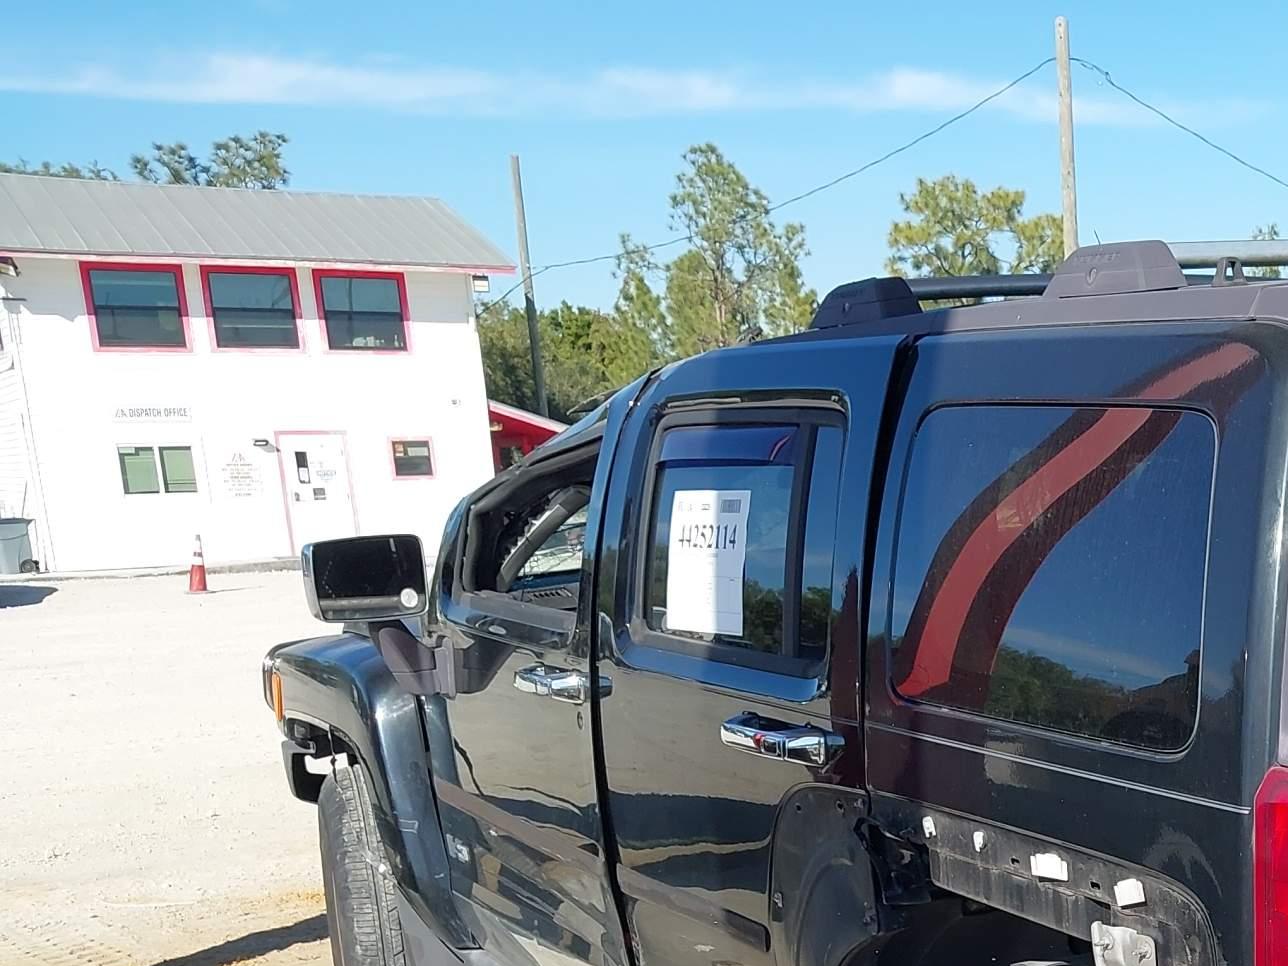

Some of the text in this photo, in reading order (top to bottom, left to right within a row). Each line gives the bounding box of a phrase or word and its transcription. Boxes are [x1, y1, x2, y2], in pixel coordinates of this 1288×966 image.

[128, 407, 162, 418] DISPATCH
[163, 407, 188, 417] OFFICE
[677, 523, 738, 550] 44252114
